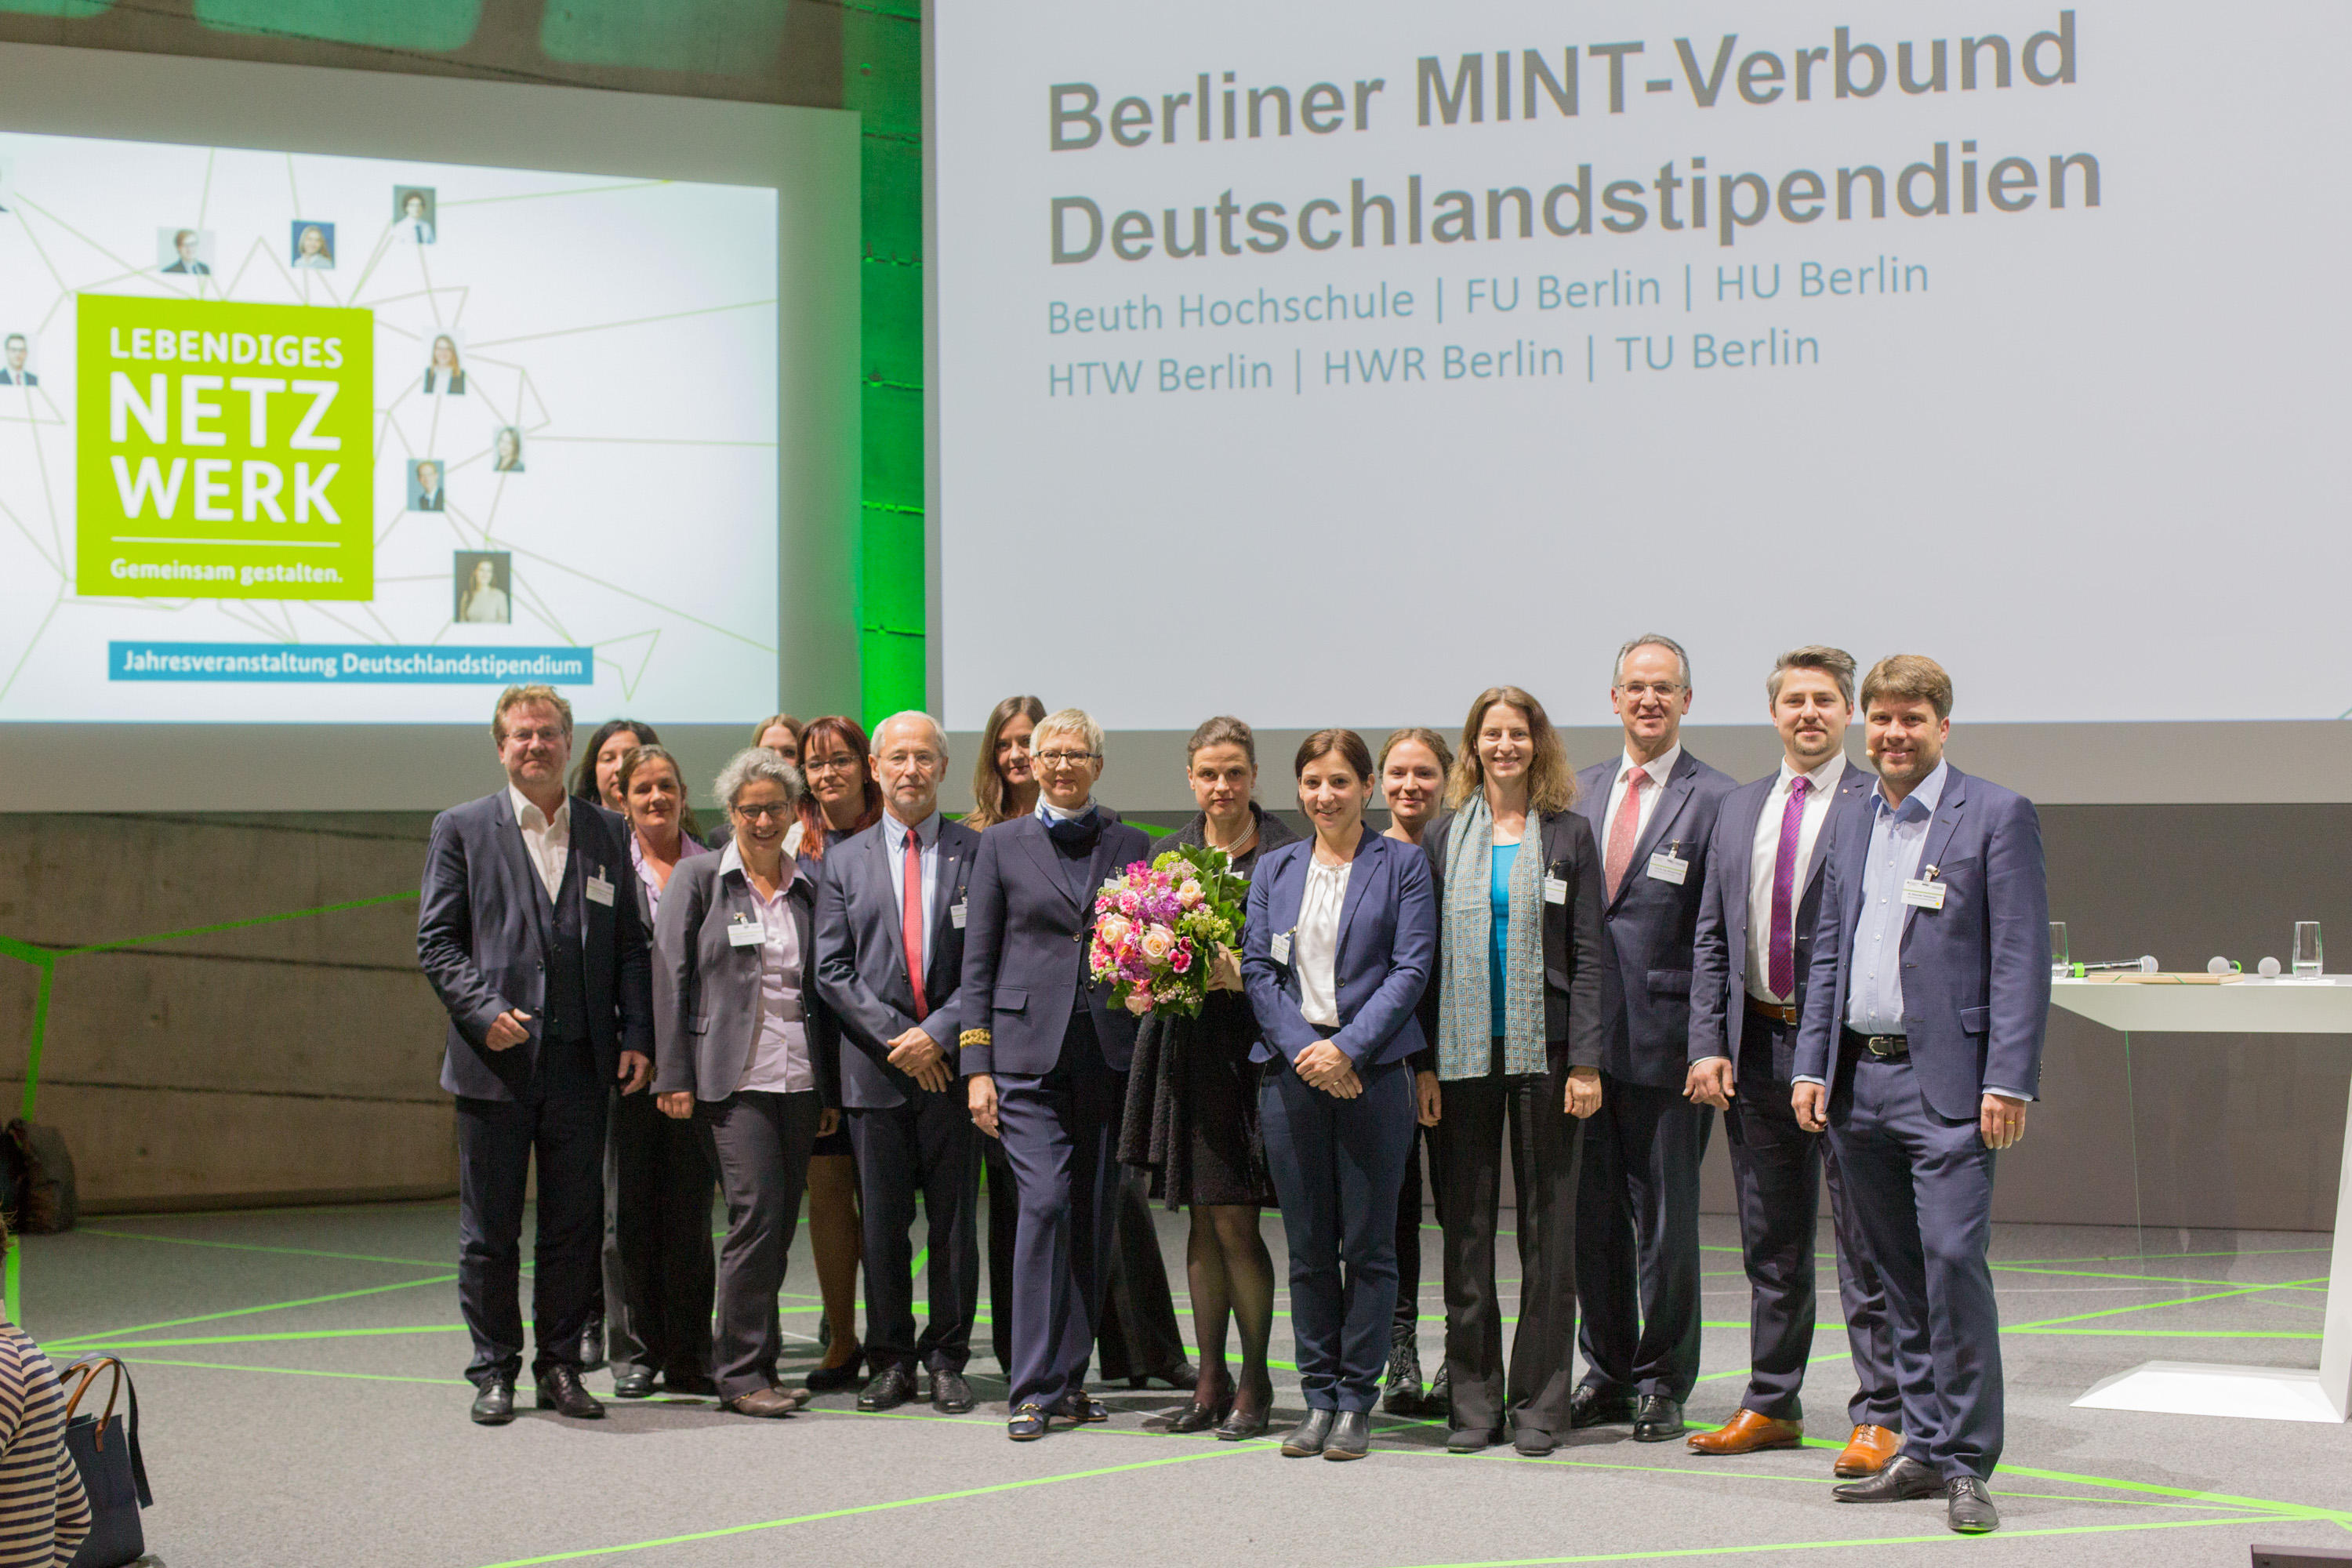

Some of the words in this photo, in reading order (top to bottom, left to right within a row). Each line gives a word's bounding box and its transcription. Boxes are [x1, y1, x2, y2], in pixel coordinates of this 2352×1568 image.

[1050, 70, 1386, 151] Berliner
[1417, 9, 2077, 126] MINT-Verbund
[1051, 139, 2100, 264] Deutschlandstipendien
[1049, 294, 1163, 335] Beuth
[1180, 281, 1414, 328] Hochschule
[1468, 274, 1519, 314] FU
[1538, 268, 1660, 310] Berlin
[1718, 261, 1780, 301] HU
[1801, 255, 1928, 296] Berlin
[110, 326, 343, 369] LEBENDIGES
[1050, 358, 1143, 396] HTW
[1159, 351, 1272, 392] Berlin
[1325, 344, 1426, 384] HWR
[1443, 339, 1563, 379] Berlin
[1616, 335, 1673, 372] TU
[1693, 327, 1818, 368] Berlin
[110, 372, 342, 451] NETZ
[110, 455, 342, 524] WERK
[110, 557, 236, 582] Gemeinsam
[240, 560, 343, 587] gestalten.
[123, 649, 338, 678] Jahresveranstaltung
[342, 652, 583, 679] Deutschlandstipendium
